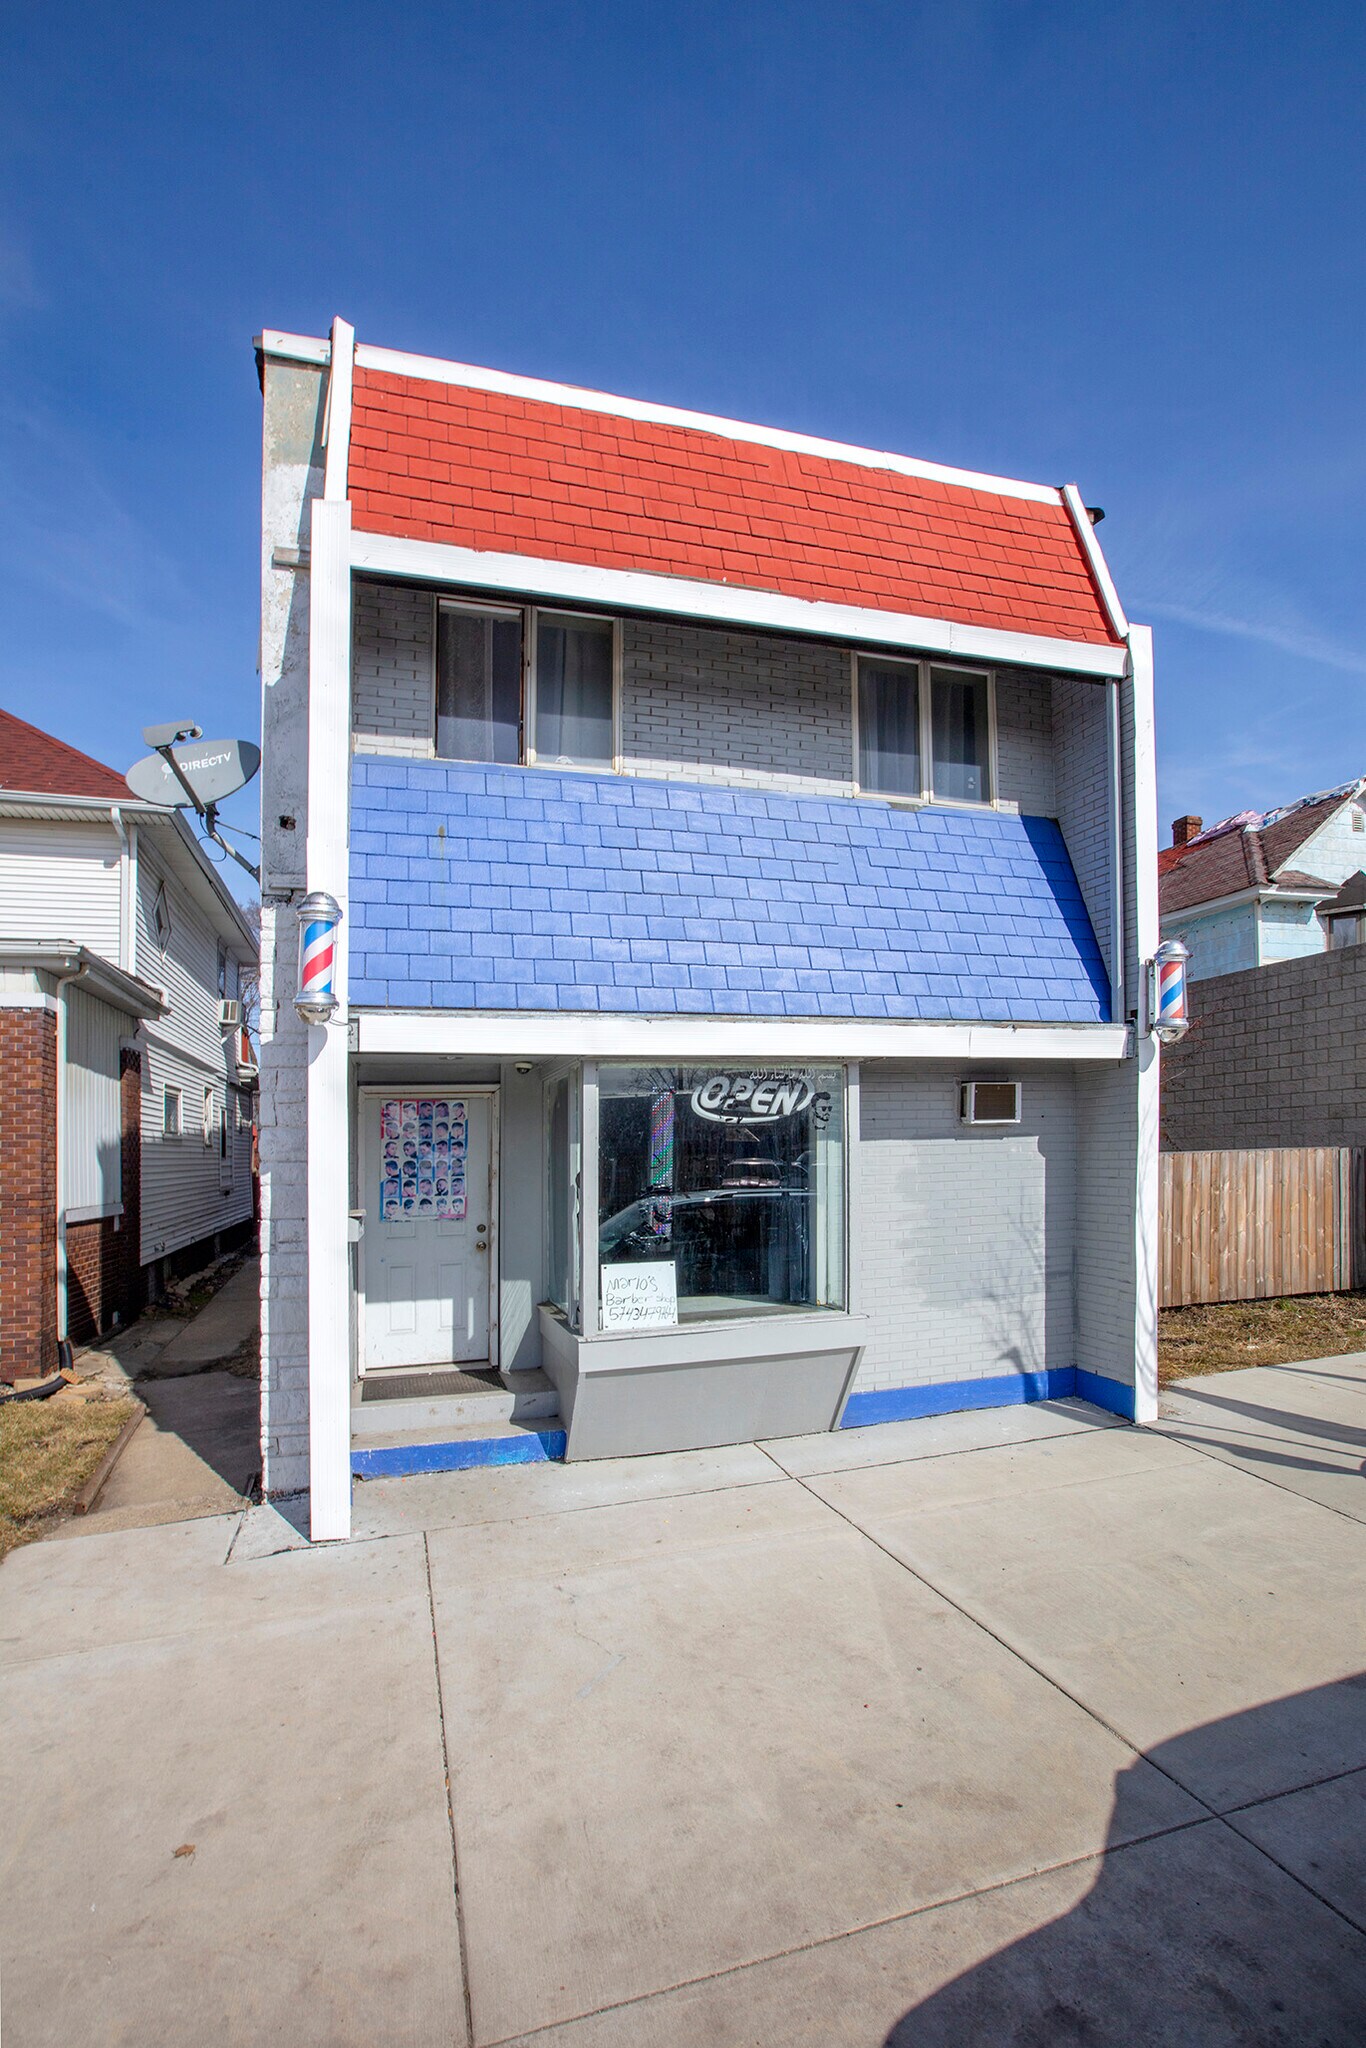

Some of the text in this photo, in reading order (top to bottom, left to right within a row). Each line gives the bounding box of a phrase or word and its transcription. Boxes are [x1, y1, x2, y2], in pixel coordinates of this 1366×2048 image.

[180, 752, 231, 772] DIRECTV
[702, 1077, 800, 1117] OPEN
[605, 1292, 652, 1306] Barber
